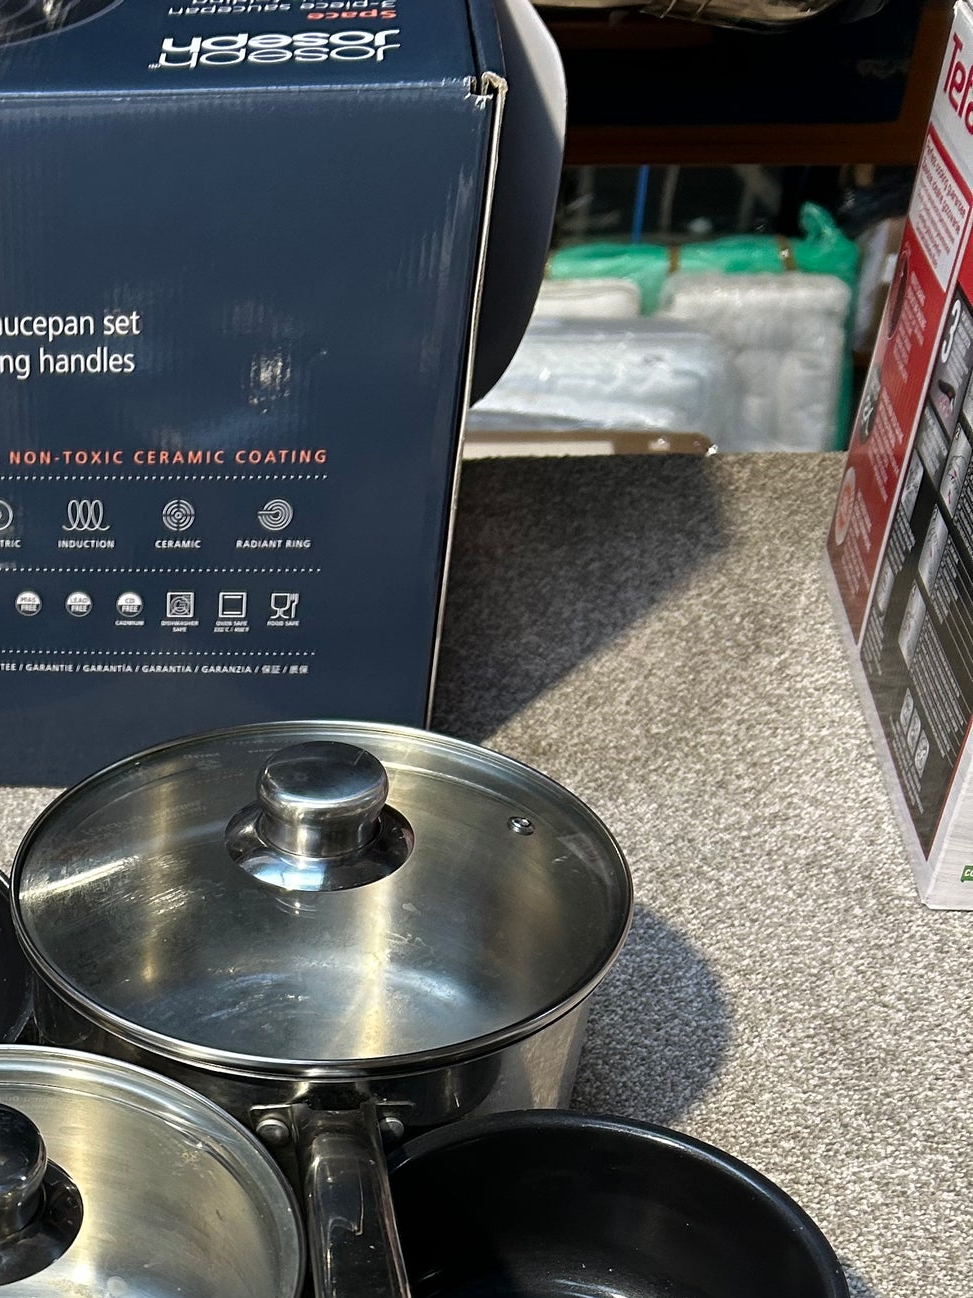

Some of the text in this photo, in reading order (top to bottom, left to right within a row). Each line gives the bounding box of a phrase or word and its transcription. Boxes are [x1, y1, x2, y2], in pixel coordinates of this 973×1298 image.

[307, 9, 397, 20] Space
[161, 29, 401, 53] Joseph
[103, 310, 141, 336] set
[39, 346, 136, 374] handles
[10, 450, 124, 466] NON-TOXIC
[133, 450, 225, 465] CERAMIC
[235, 449, 327, 465] COATING
[57, 539, 115, 549] INDUCTION
[154, 539, 202, 549] CERAMIC
[236, 539, 312, 549] RADIANT RING
[25, 663, 73, 672] GARANTIE
[201, 665, 252, 674] GARANZIA
